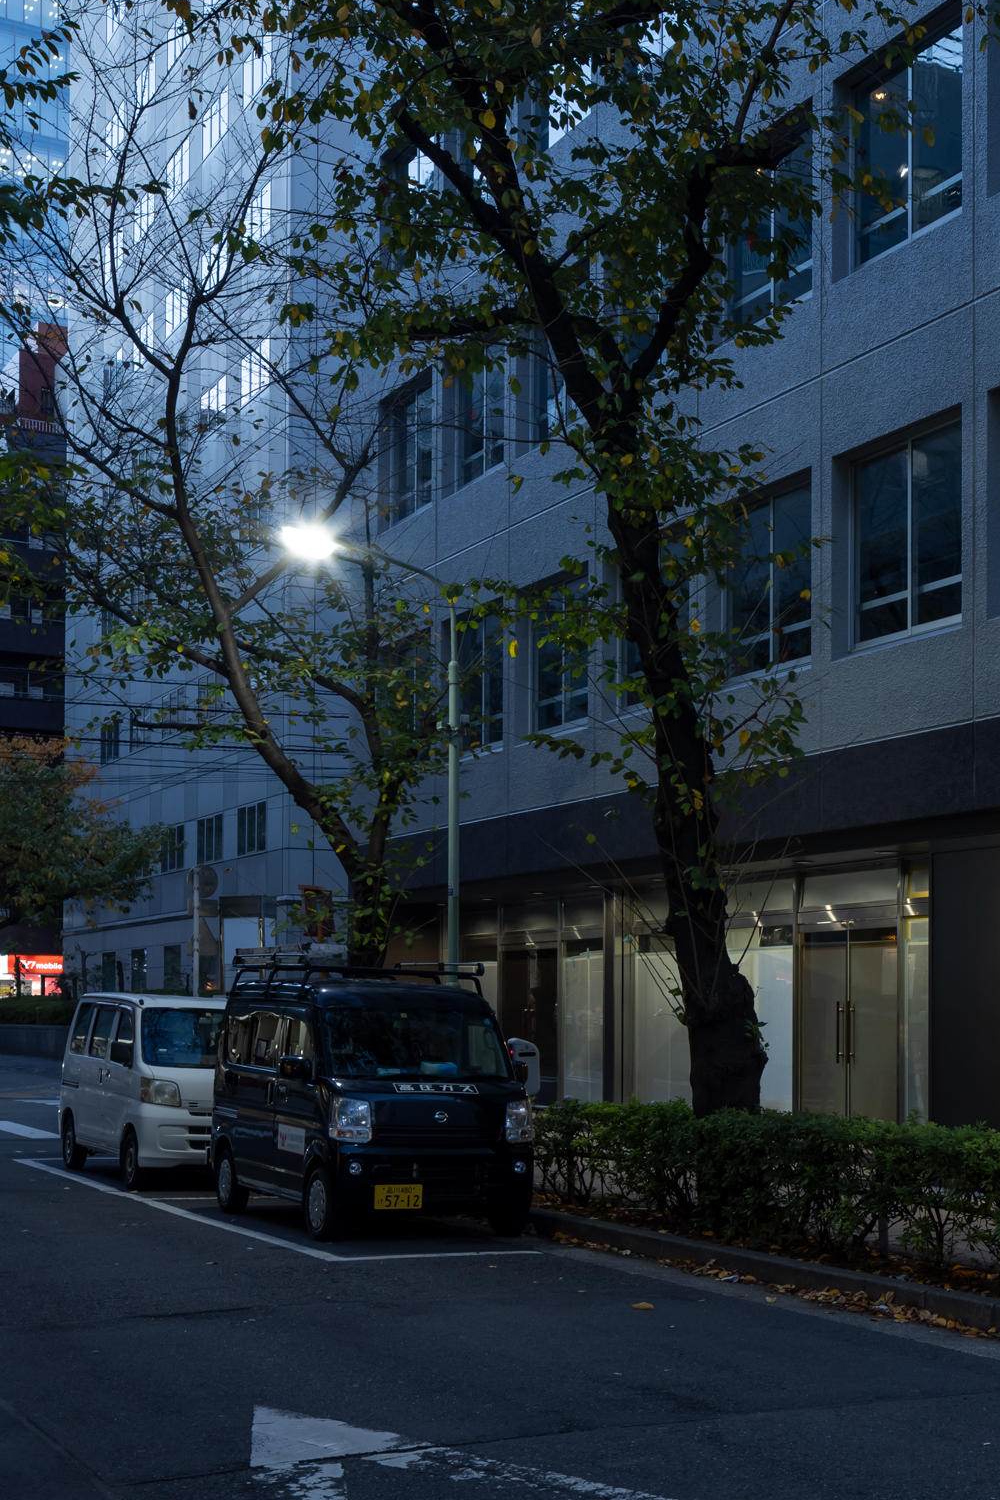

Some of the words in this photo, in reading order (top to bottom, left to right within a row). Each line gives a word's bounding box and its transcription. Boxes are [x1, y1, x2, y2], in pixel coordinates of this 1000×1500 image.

[399, 1083, 475, 1093] 高圧ガス
[385, 1194, 420, 1207] 57-12
